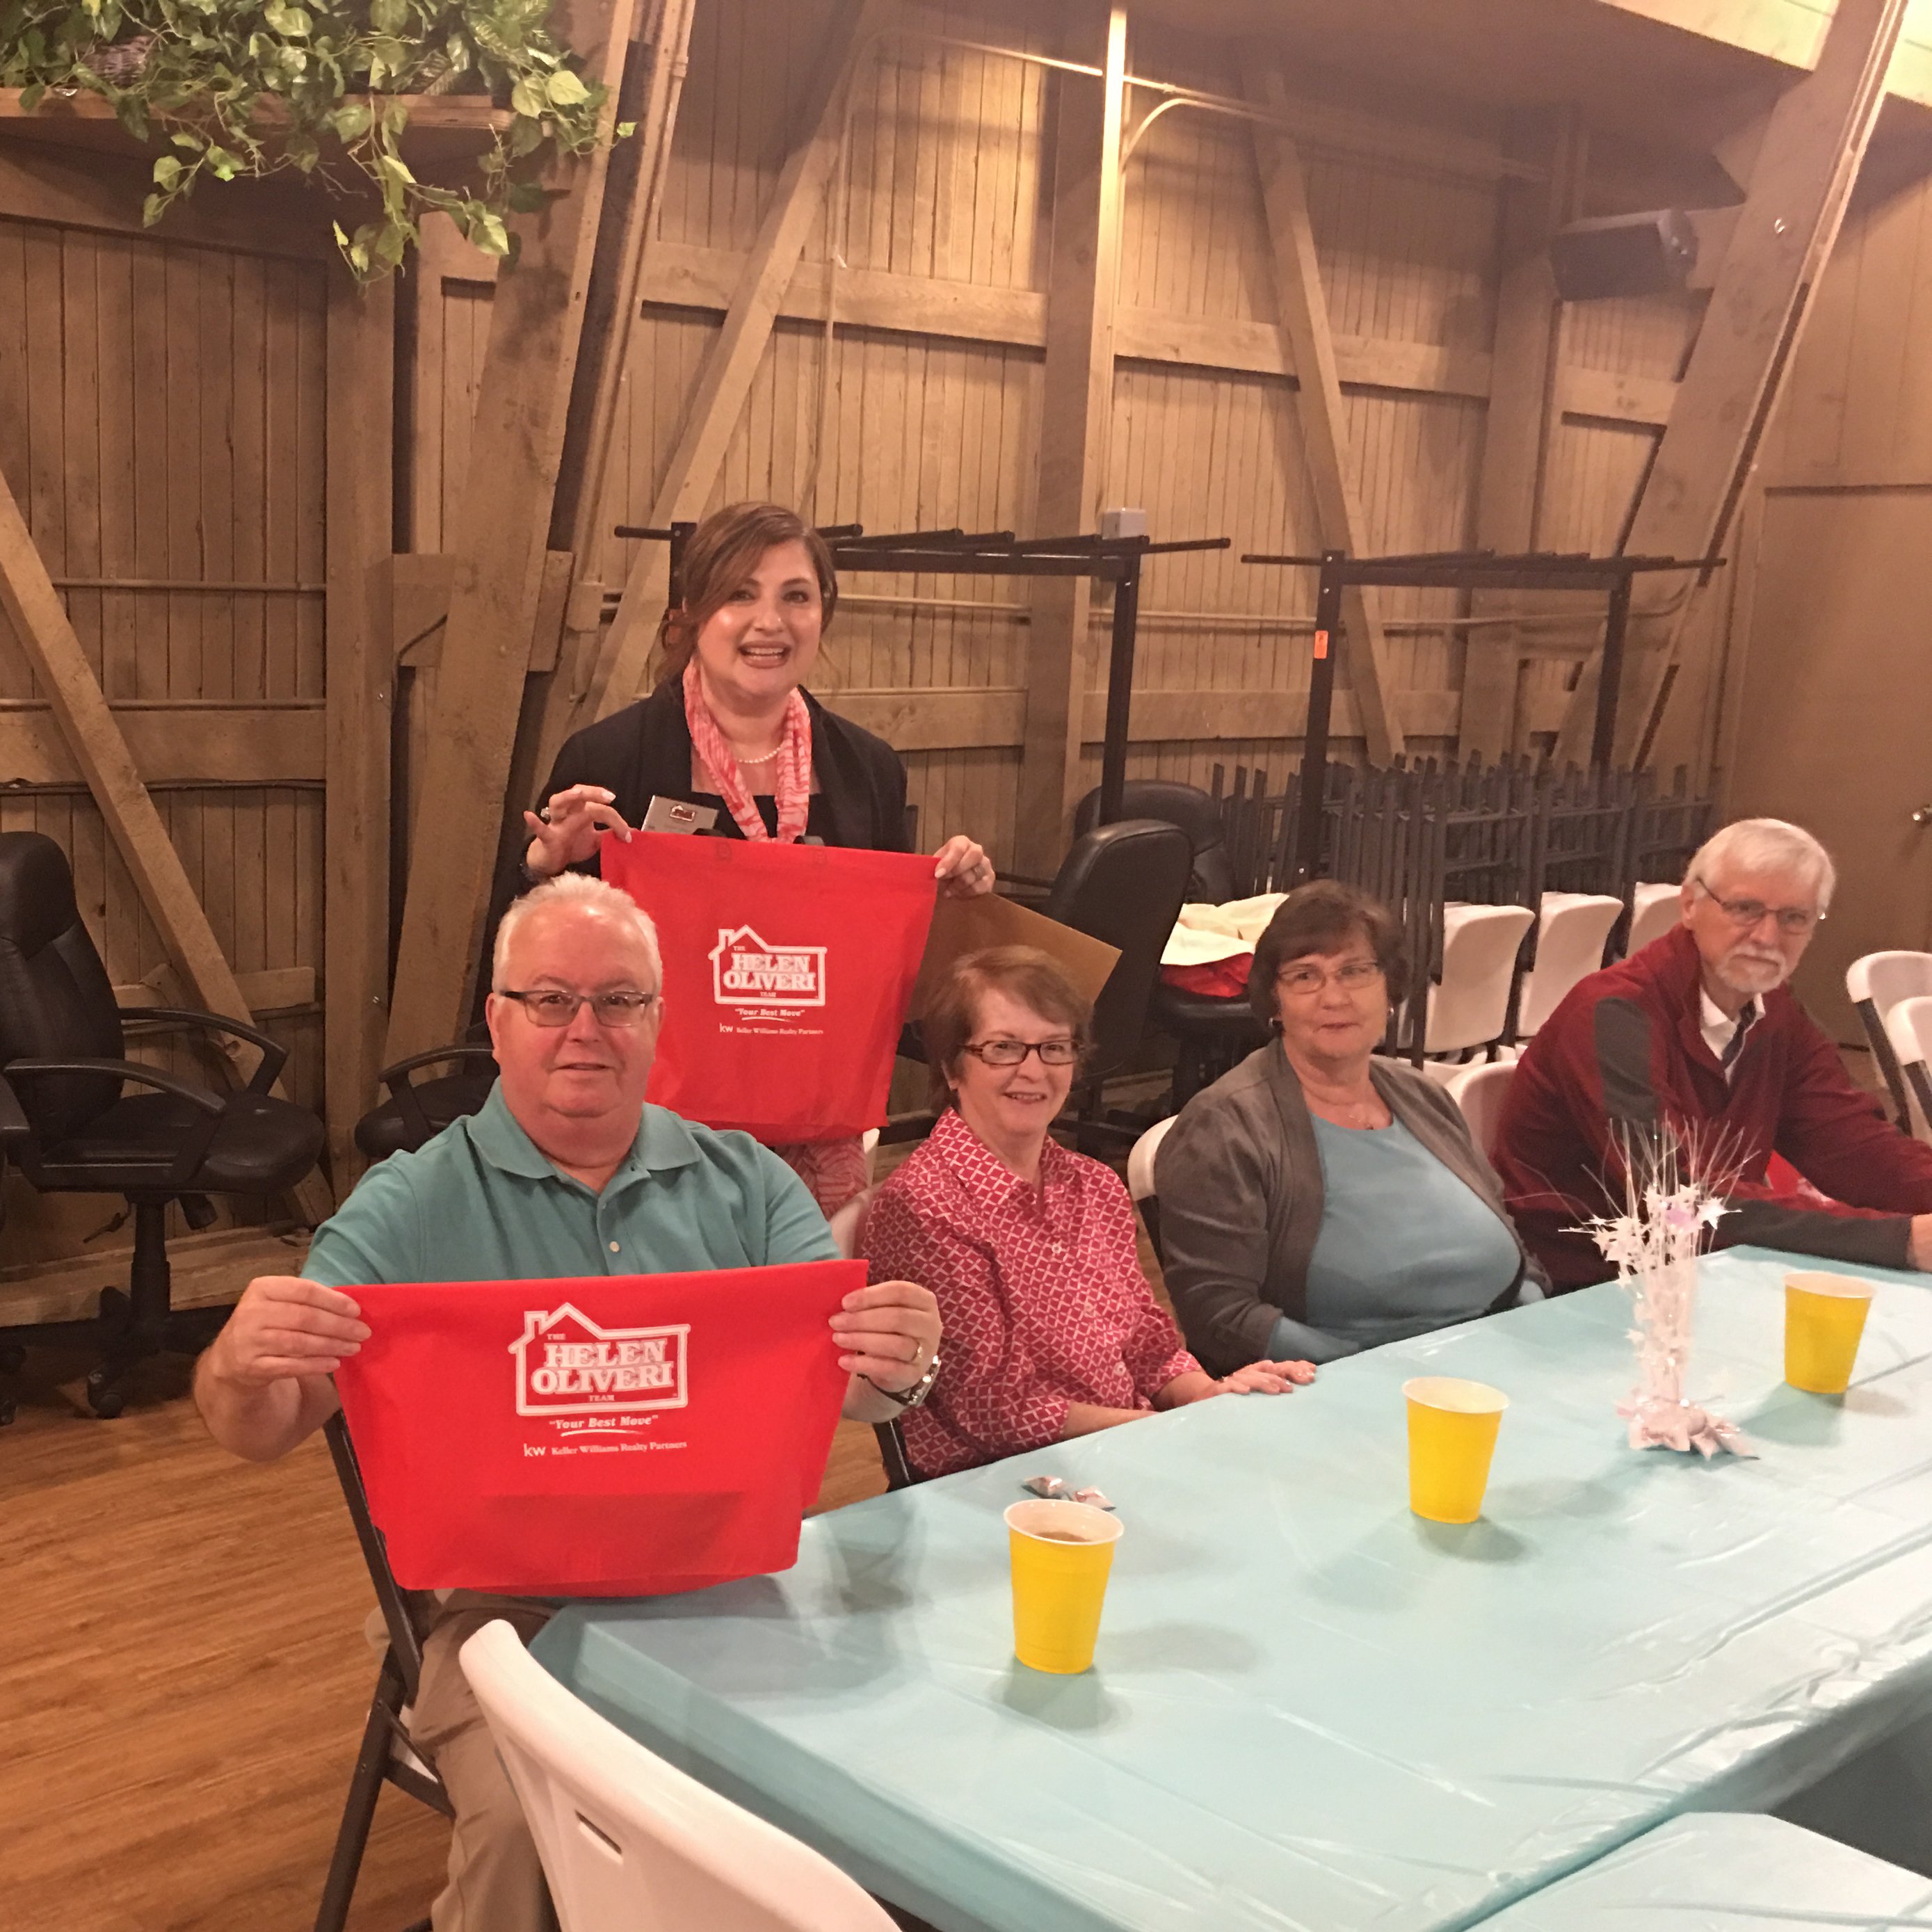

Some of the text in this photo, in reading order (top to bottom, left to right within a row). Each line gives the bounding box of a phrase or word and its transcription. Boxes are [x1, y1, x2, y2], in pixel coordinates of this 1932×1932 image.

[732, 953, 811, 973] HELEN
[723, 970, 816, 991] OLIVERI
[719, 1022, 734, 1033] kw
[545, 1339, 667, 1368] HELEN
[531, 1362, 673, 1394] OLIVERI
[588, 1417, 616, 1428] Best
[524, 1443, 547, 1457] kw
[620, 1443, 647, 1452] Realty
[650, 1442, 687, 1450] Partners
